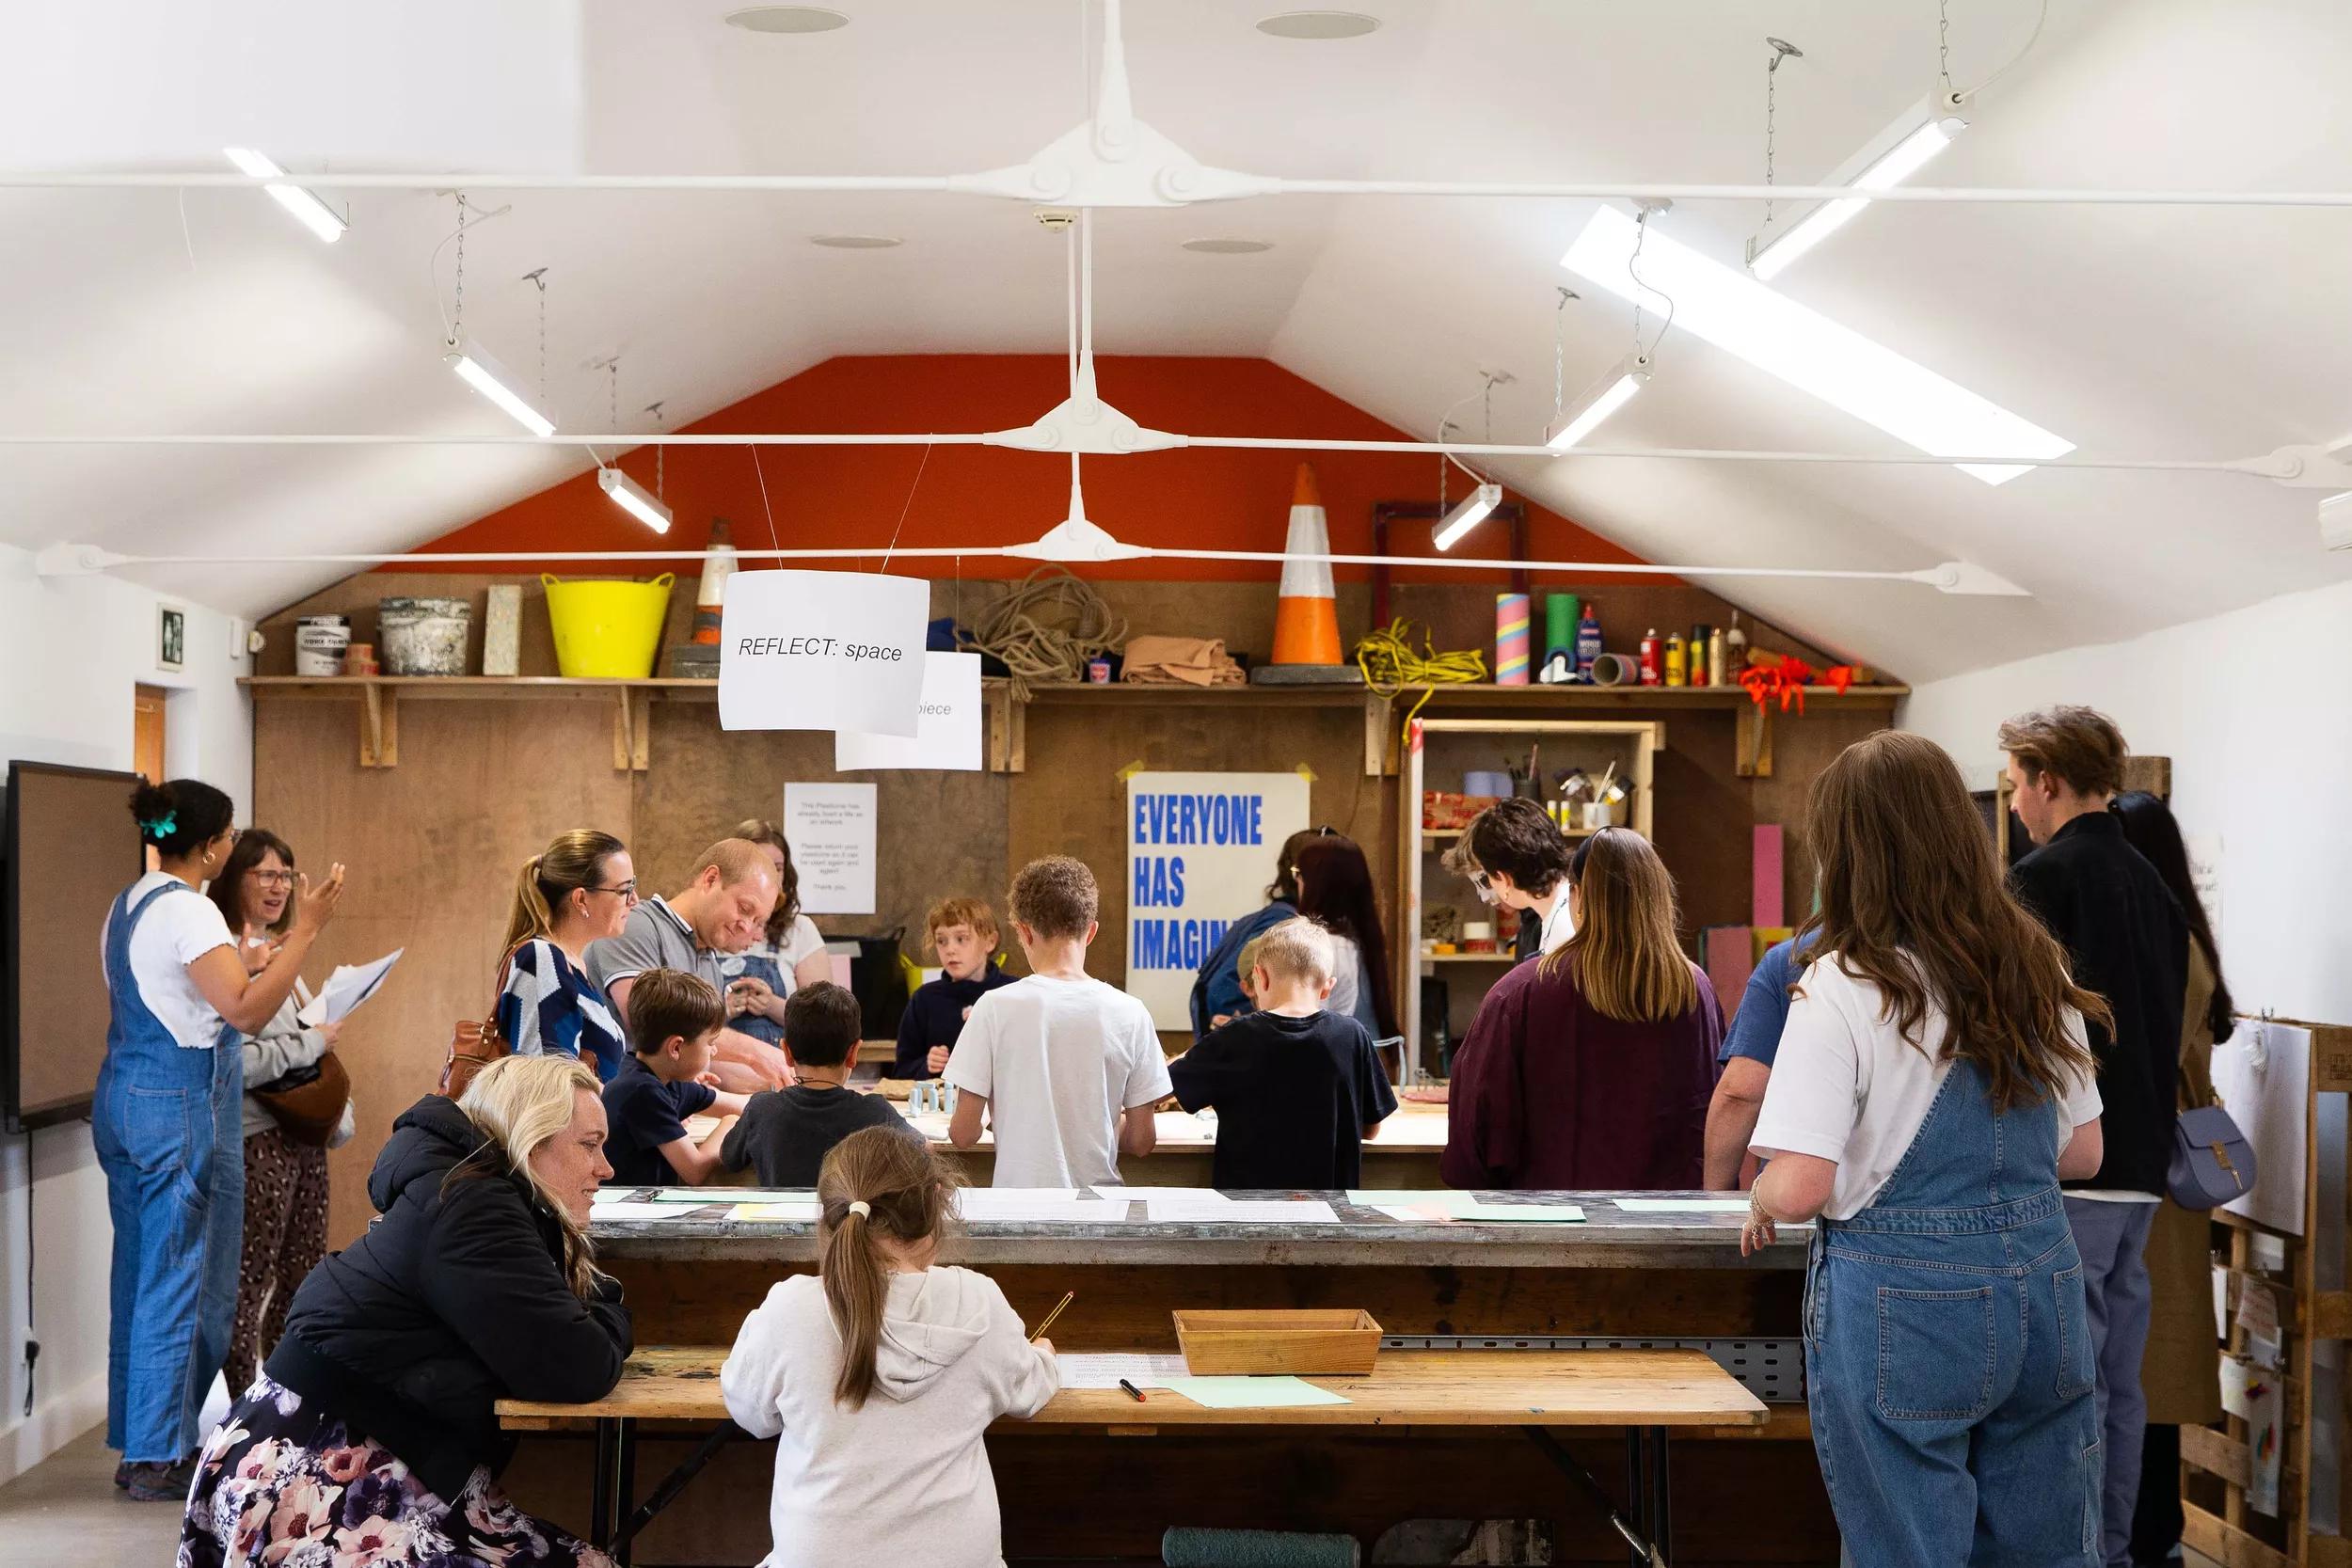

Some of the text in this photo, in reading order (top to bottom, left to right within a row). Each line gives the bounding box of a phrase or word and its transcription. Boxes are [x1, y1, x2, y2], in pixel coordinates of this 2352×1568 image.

[739, 637, 902, 662] REFLECT: space
[1135, 794, 1263, 846] EVERYONE
[1134, 856, 1184, 908] HAS
